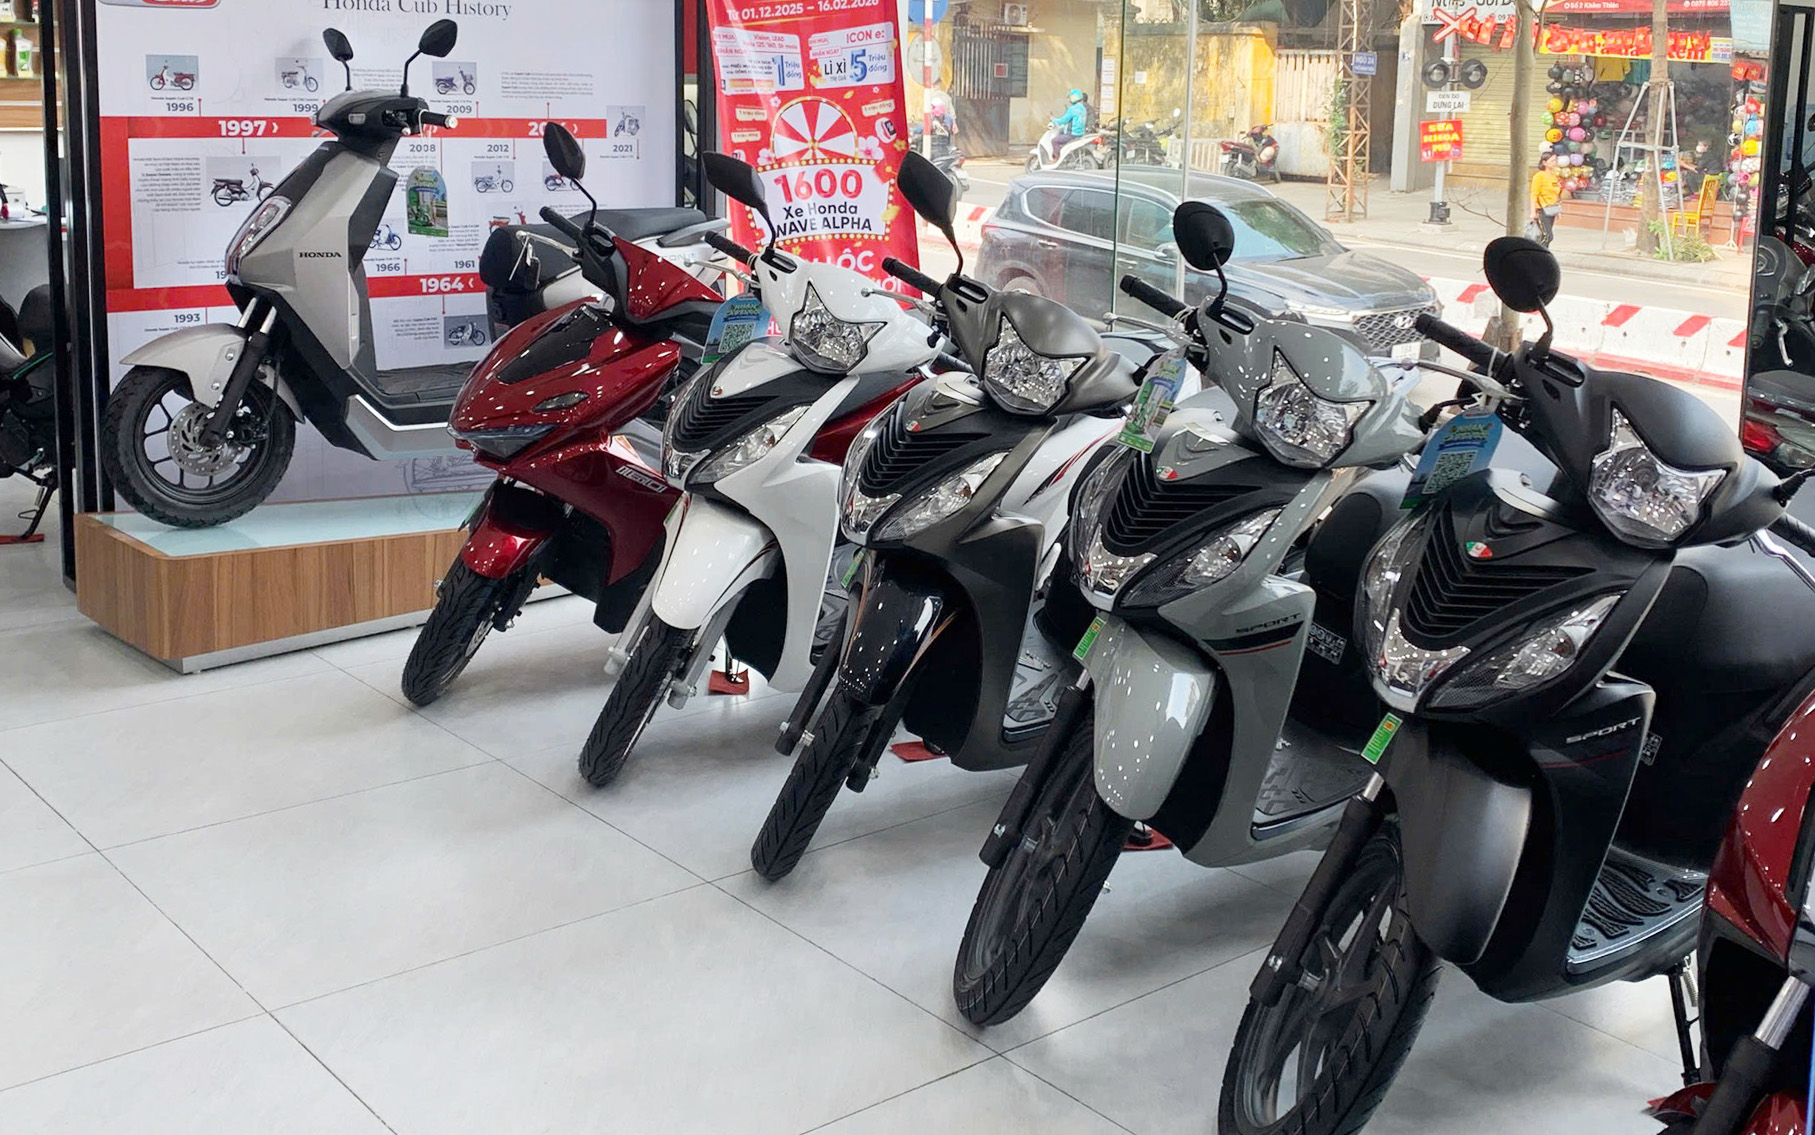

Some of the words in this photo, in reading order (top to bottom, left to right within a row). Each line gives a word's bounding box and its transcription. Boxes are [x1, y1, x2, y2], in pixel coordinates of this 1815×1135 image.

[323, 0, 391, 12] Honda
[399, 0, 438, 13] Cub
[446, 0, 512, 20] History
[741, 5, 803, 20] 01.12.2025
[846, 30, 872, 44] ICON
[849, 48, 868, 82] 5
[166, 102, 194, 112] 1996
[293, 103, 319, 113] 1999
[446, 105, 473, 114] 2009
[218, 119, 267, 137] 1997
[487, 144, 509, 153] 2012
[613, 144, 633, 153] 2021
[773, 168, 863, 203] 1600
[783, 205, 804, 220] Xe
[808, 202, 858, 217] Honda
[821, 216, 872, 232] ALPHA
[299, 251, 342, 259] HONDA
[376, 263, 400, 272] 1966
[454, 260, 475, 269] 1961
[420, 277, 464, 293] 1964
[174, 313, 200, 323] 1993
[1236, 612, 1301, 634] SPORT
[1565, 716, 1642, 744] SPORT
